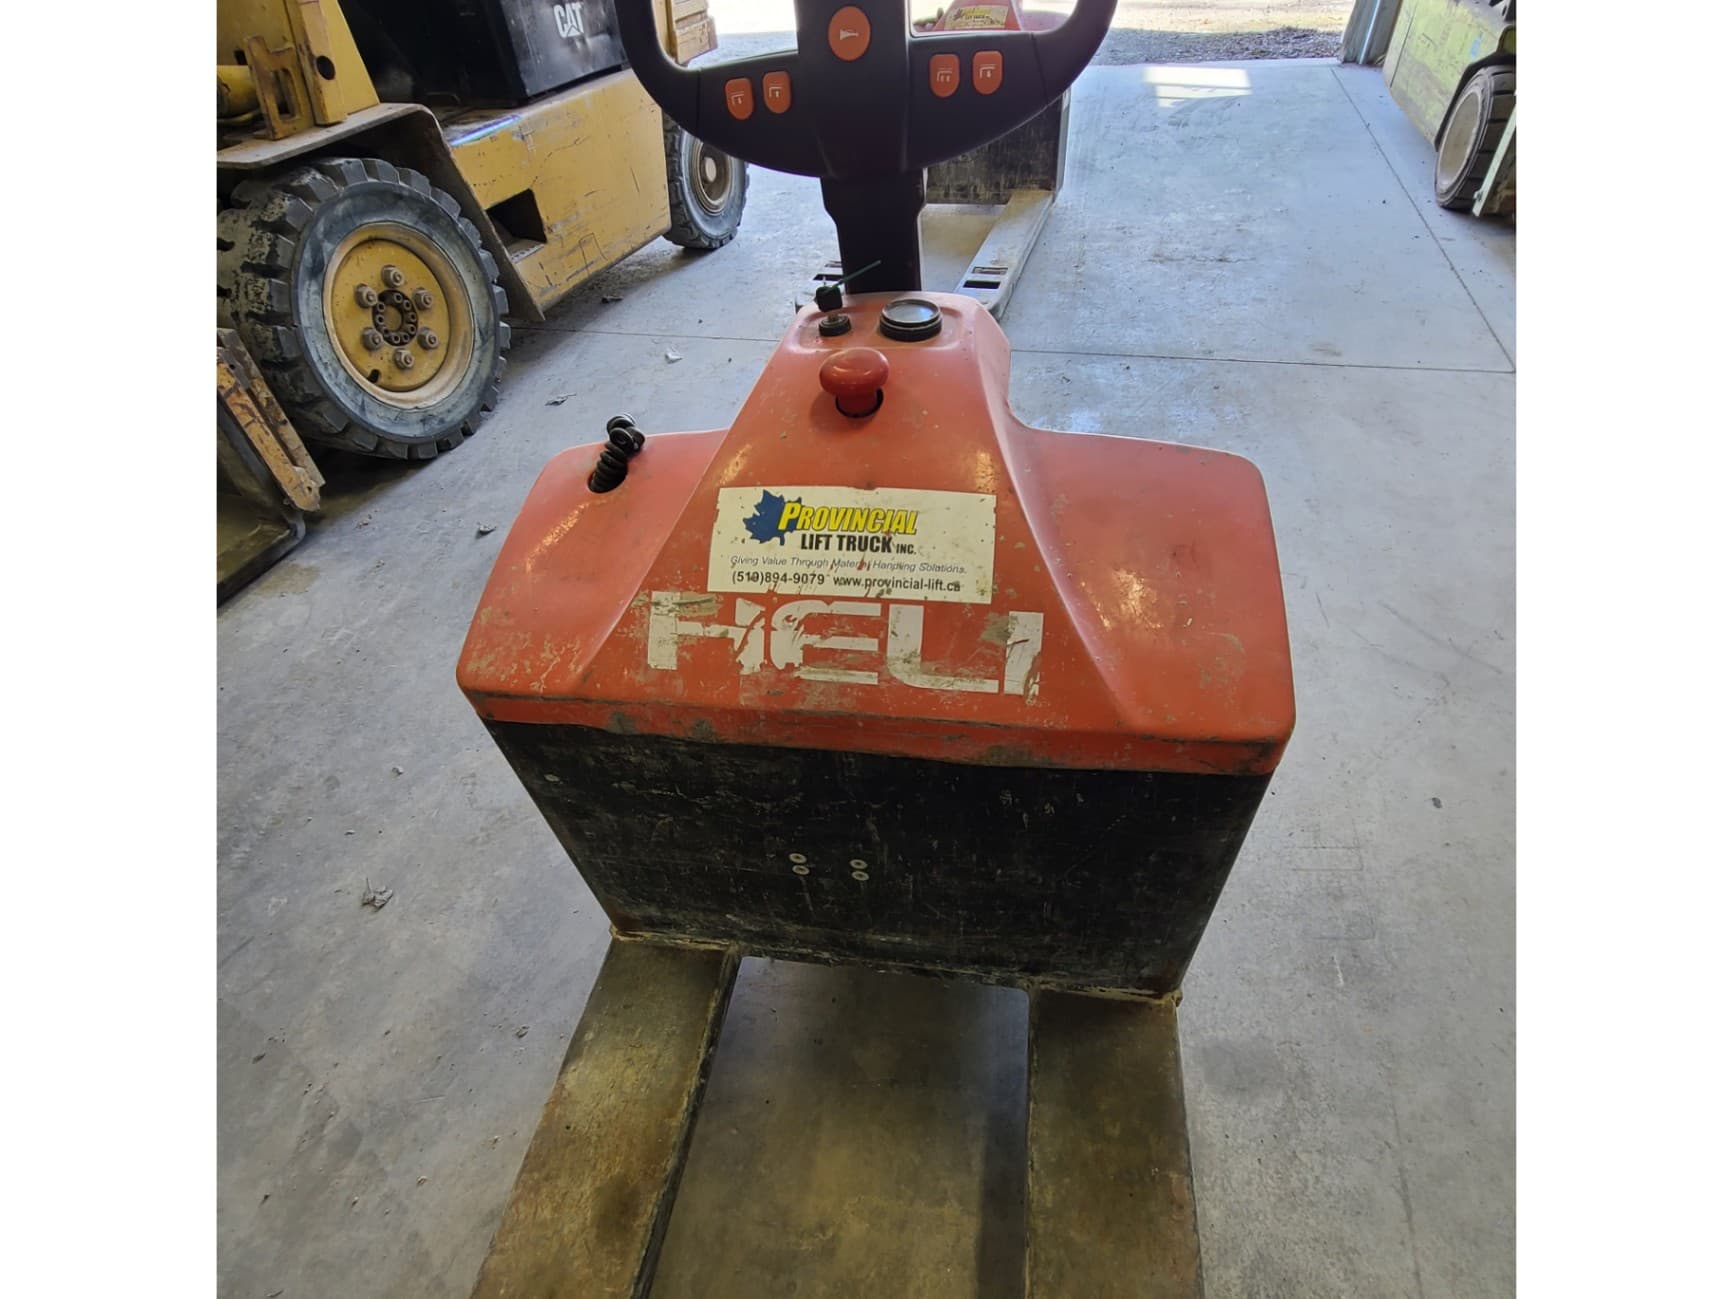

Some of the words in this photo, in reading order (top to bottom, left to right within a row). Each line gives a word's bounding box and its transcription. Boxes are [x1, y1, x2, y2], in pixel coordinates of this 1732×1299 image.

[553, 2, 584, 38] CAT
[777, 501, 918, 535] PROVINCIAL
[800, 534, 832, 550] LIFT
[836, 535, 892, 553] TRUCK
[896, 543, 917, 555] INC.
[731, 556, 759, 567] Giving
[762, 556, 787, 566] Value
[790, 557, 828, 569] Through
[830, 558, 870, 570] Materal
[872, 560, 915, 573] Handling
[833, 576, 961, 592] www.provincial-lift.ca
[648, 591, 1044, 698] HELI
